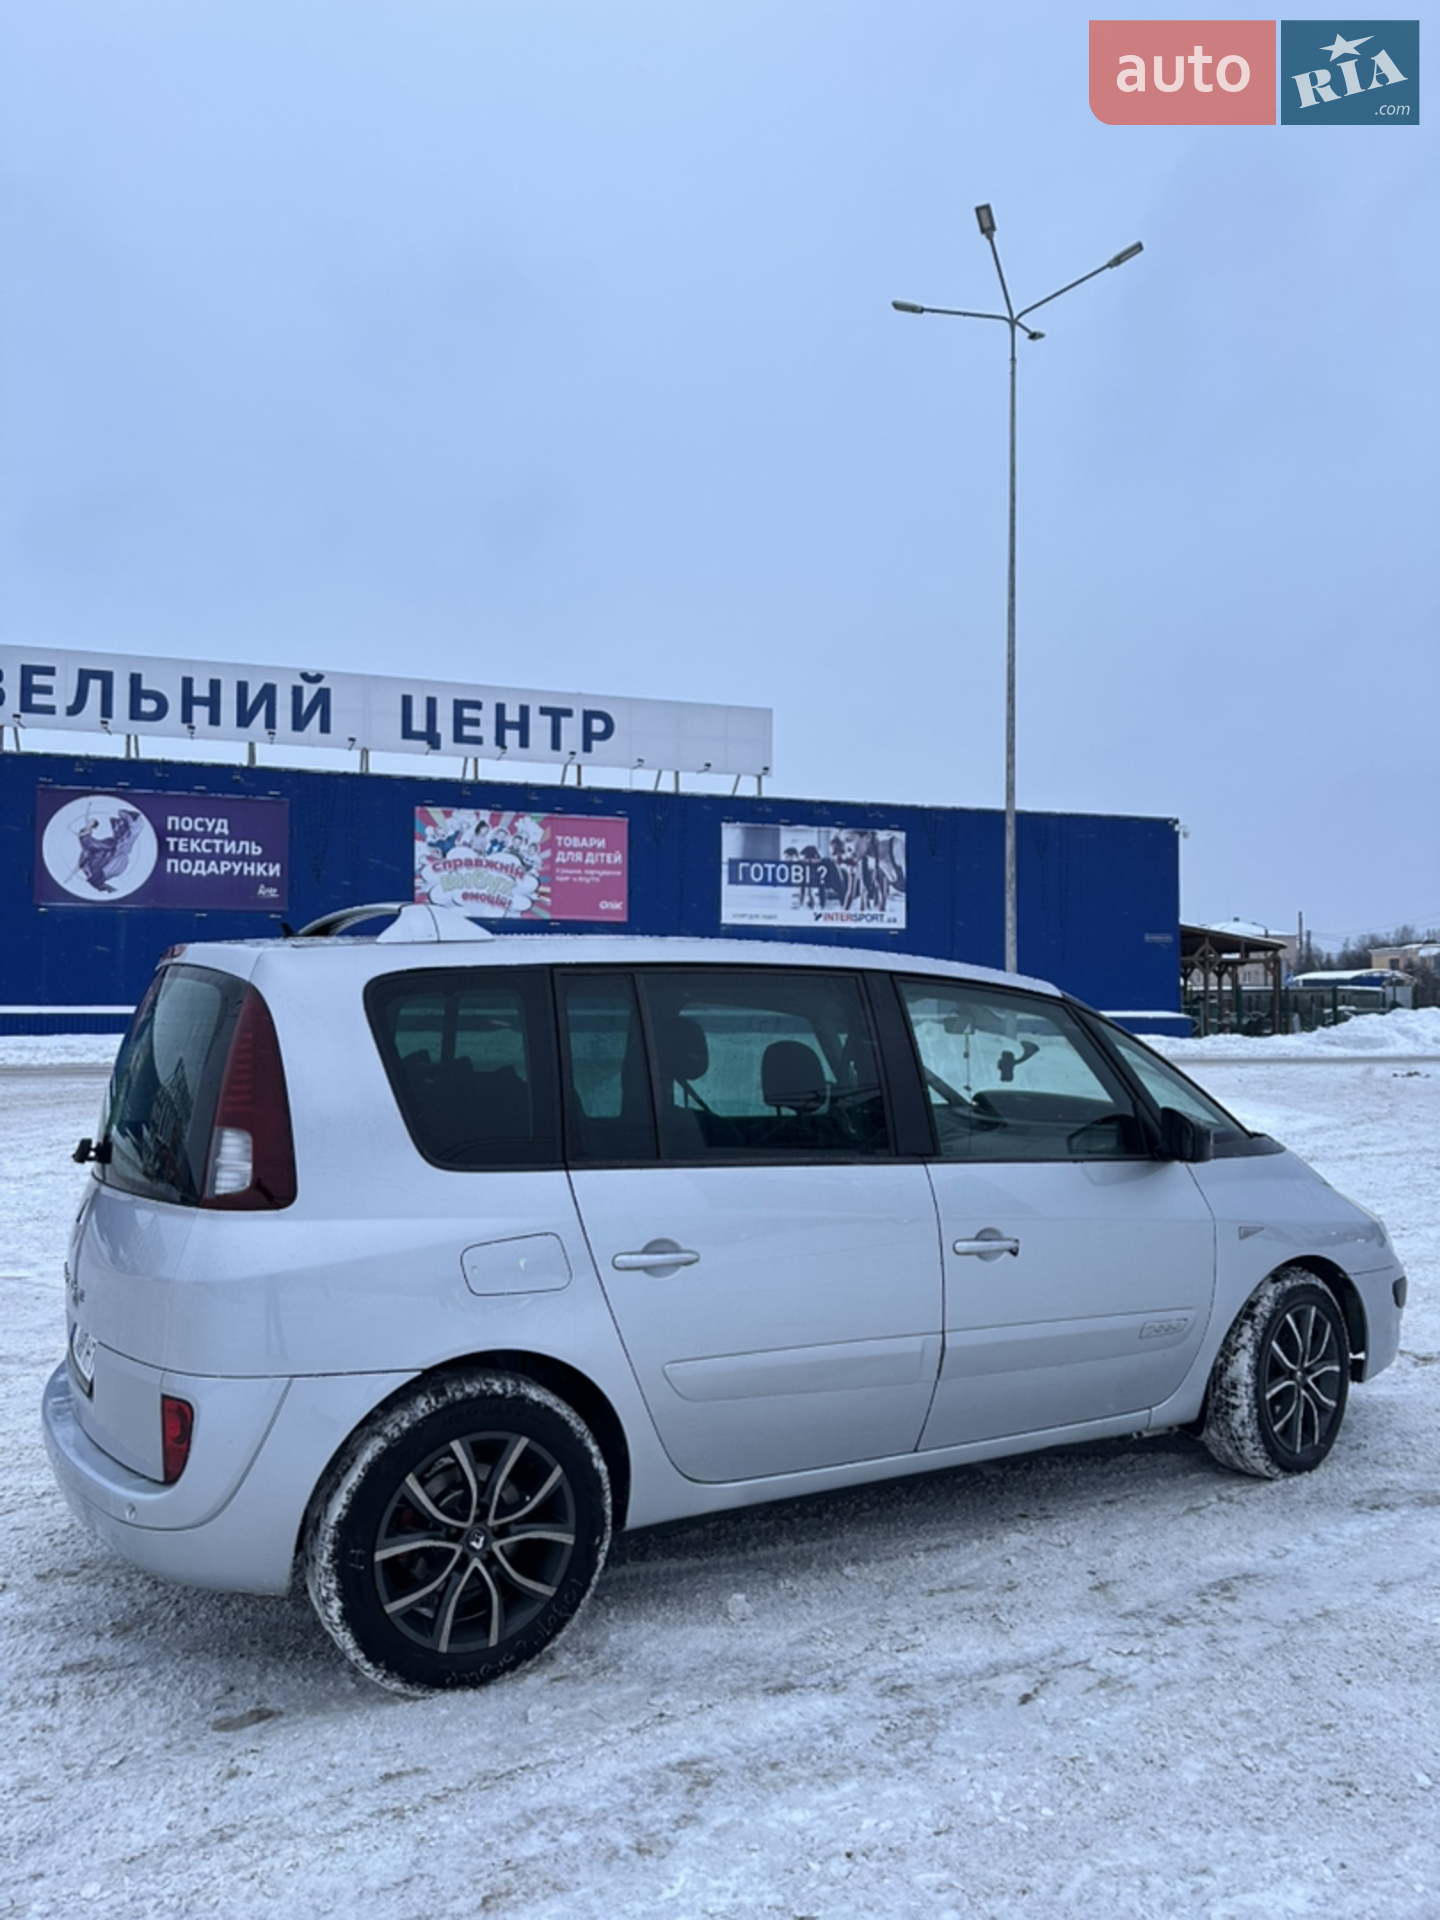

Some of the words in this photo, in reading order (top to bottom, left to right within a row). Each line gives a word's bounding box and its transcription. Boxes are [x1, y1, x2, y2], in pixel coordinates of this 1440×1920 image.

[0, 664, 331, 735] ЕЛЬНИЙ
[401, 694, 615, 753] ЦЕНТР
[167, 816, 229, 835] ПОСУД
[166, 837, 262, 855] ТЕКСТИЛЬ
[555, 835, 606, 848] ТОВАРИ
[555, 851, 583, 864] ДЛЯ
[585, 851, 622, 864] ДІТЕЙ
[166, 859, 281, 877] ПОДАРУНКИ
